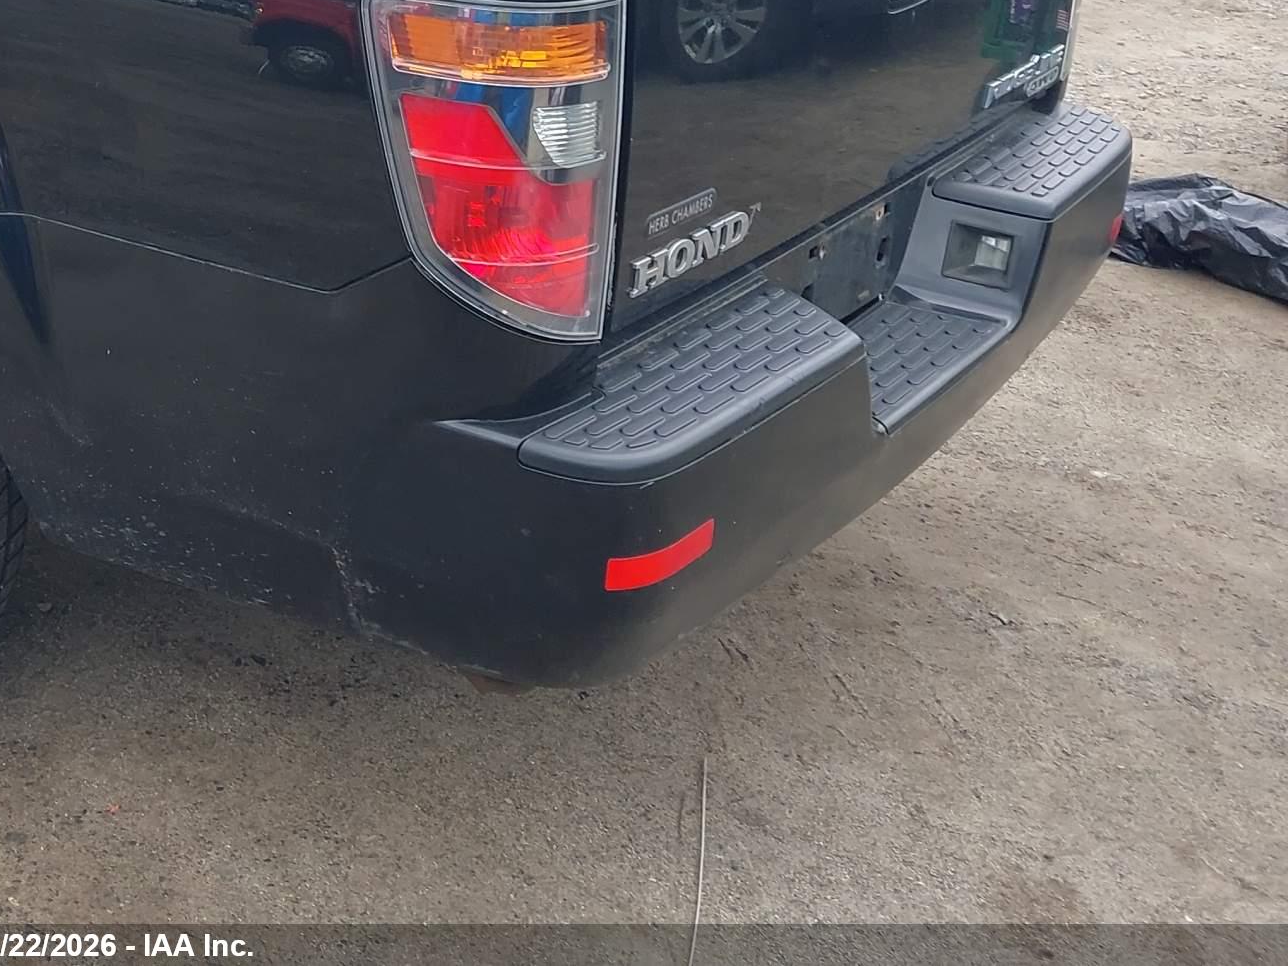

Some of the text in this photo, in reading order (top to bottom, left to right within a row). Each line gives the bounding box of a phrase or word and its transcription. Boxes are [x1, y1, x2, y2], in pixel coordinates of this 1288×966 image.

[648, 194, 714, 235] HERB CHAMBERS
[628, 202, 762, 299] HOND
